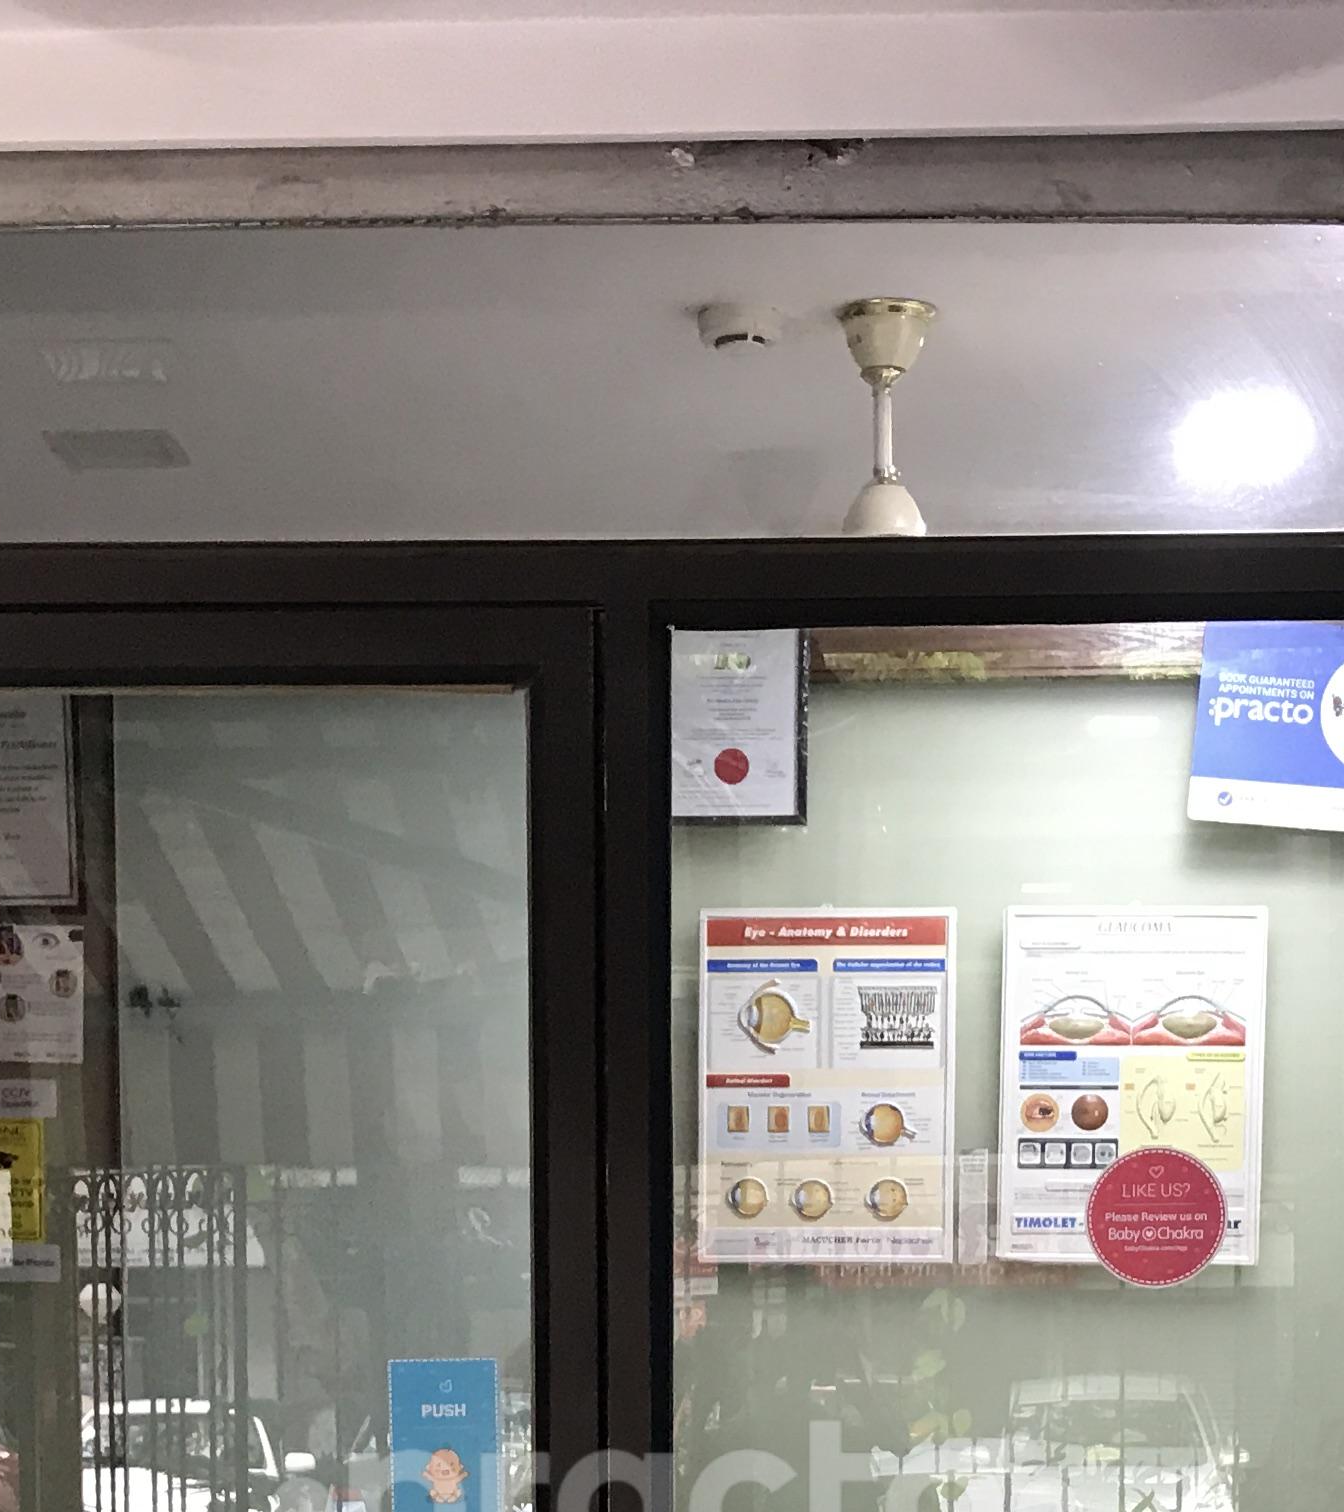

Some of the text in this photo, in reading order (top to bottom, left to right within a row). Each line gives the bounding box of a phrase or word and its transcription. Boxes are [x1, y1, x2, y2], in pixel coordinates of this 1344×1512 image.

[744, 926, 766, 939] Eye
[778, 923, 833, 939] Anatomy
[850, 923, 909, 937] Disorders
[1122, 1183, 1191, 1198] LIKE US?
[1015, 1217, 1077, 1229] TIMOLET
[1106, 1213, 1139, 1222] Please
[1142, 1212, 1178, 1221] Review
[1108, 1226, 1204, 1243] Baby Chakra
[421, 1404, 466, 1418] PUSH
